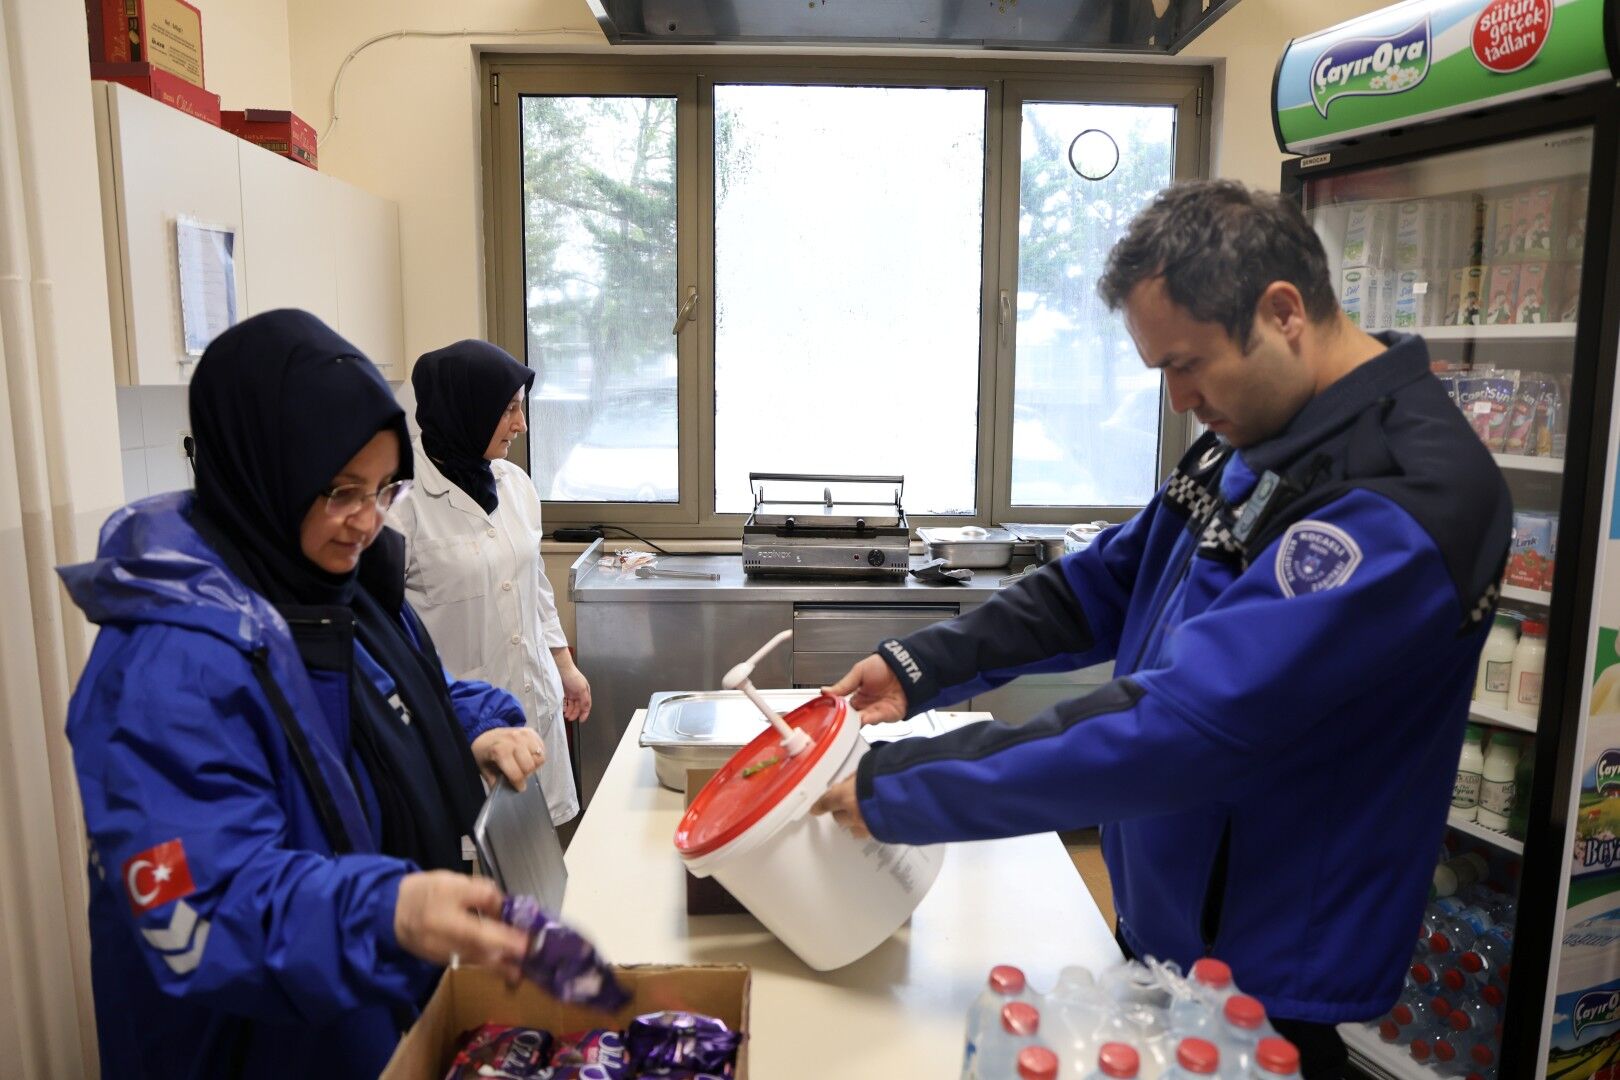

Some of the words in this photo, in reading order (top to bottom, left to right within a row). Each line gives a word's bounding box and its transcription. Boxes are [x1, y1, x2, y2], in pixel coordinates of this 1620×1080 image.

[1489, 6, 1544, 46] gerçek
[1484, 31, 1536, 63] tadları
[883, 639, 922, 684] ZABITA
